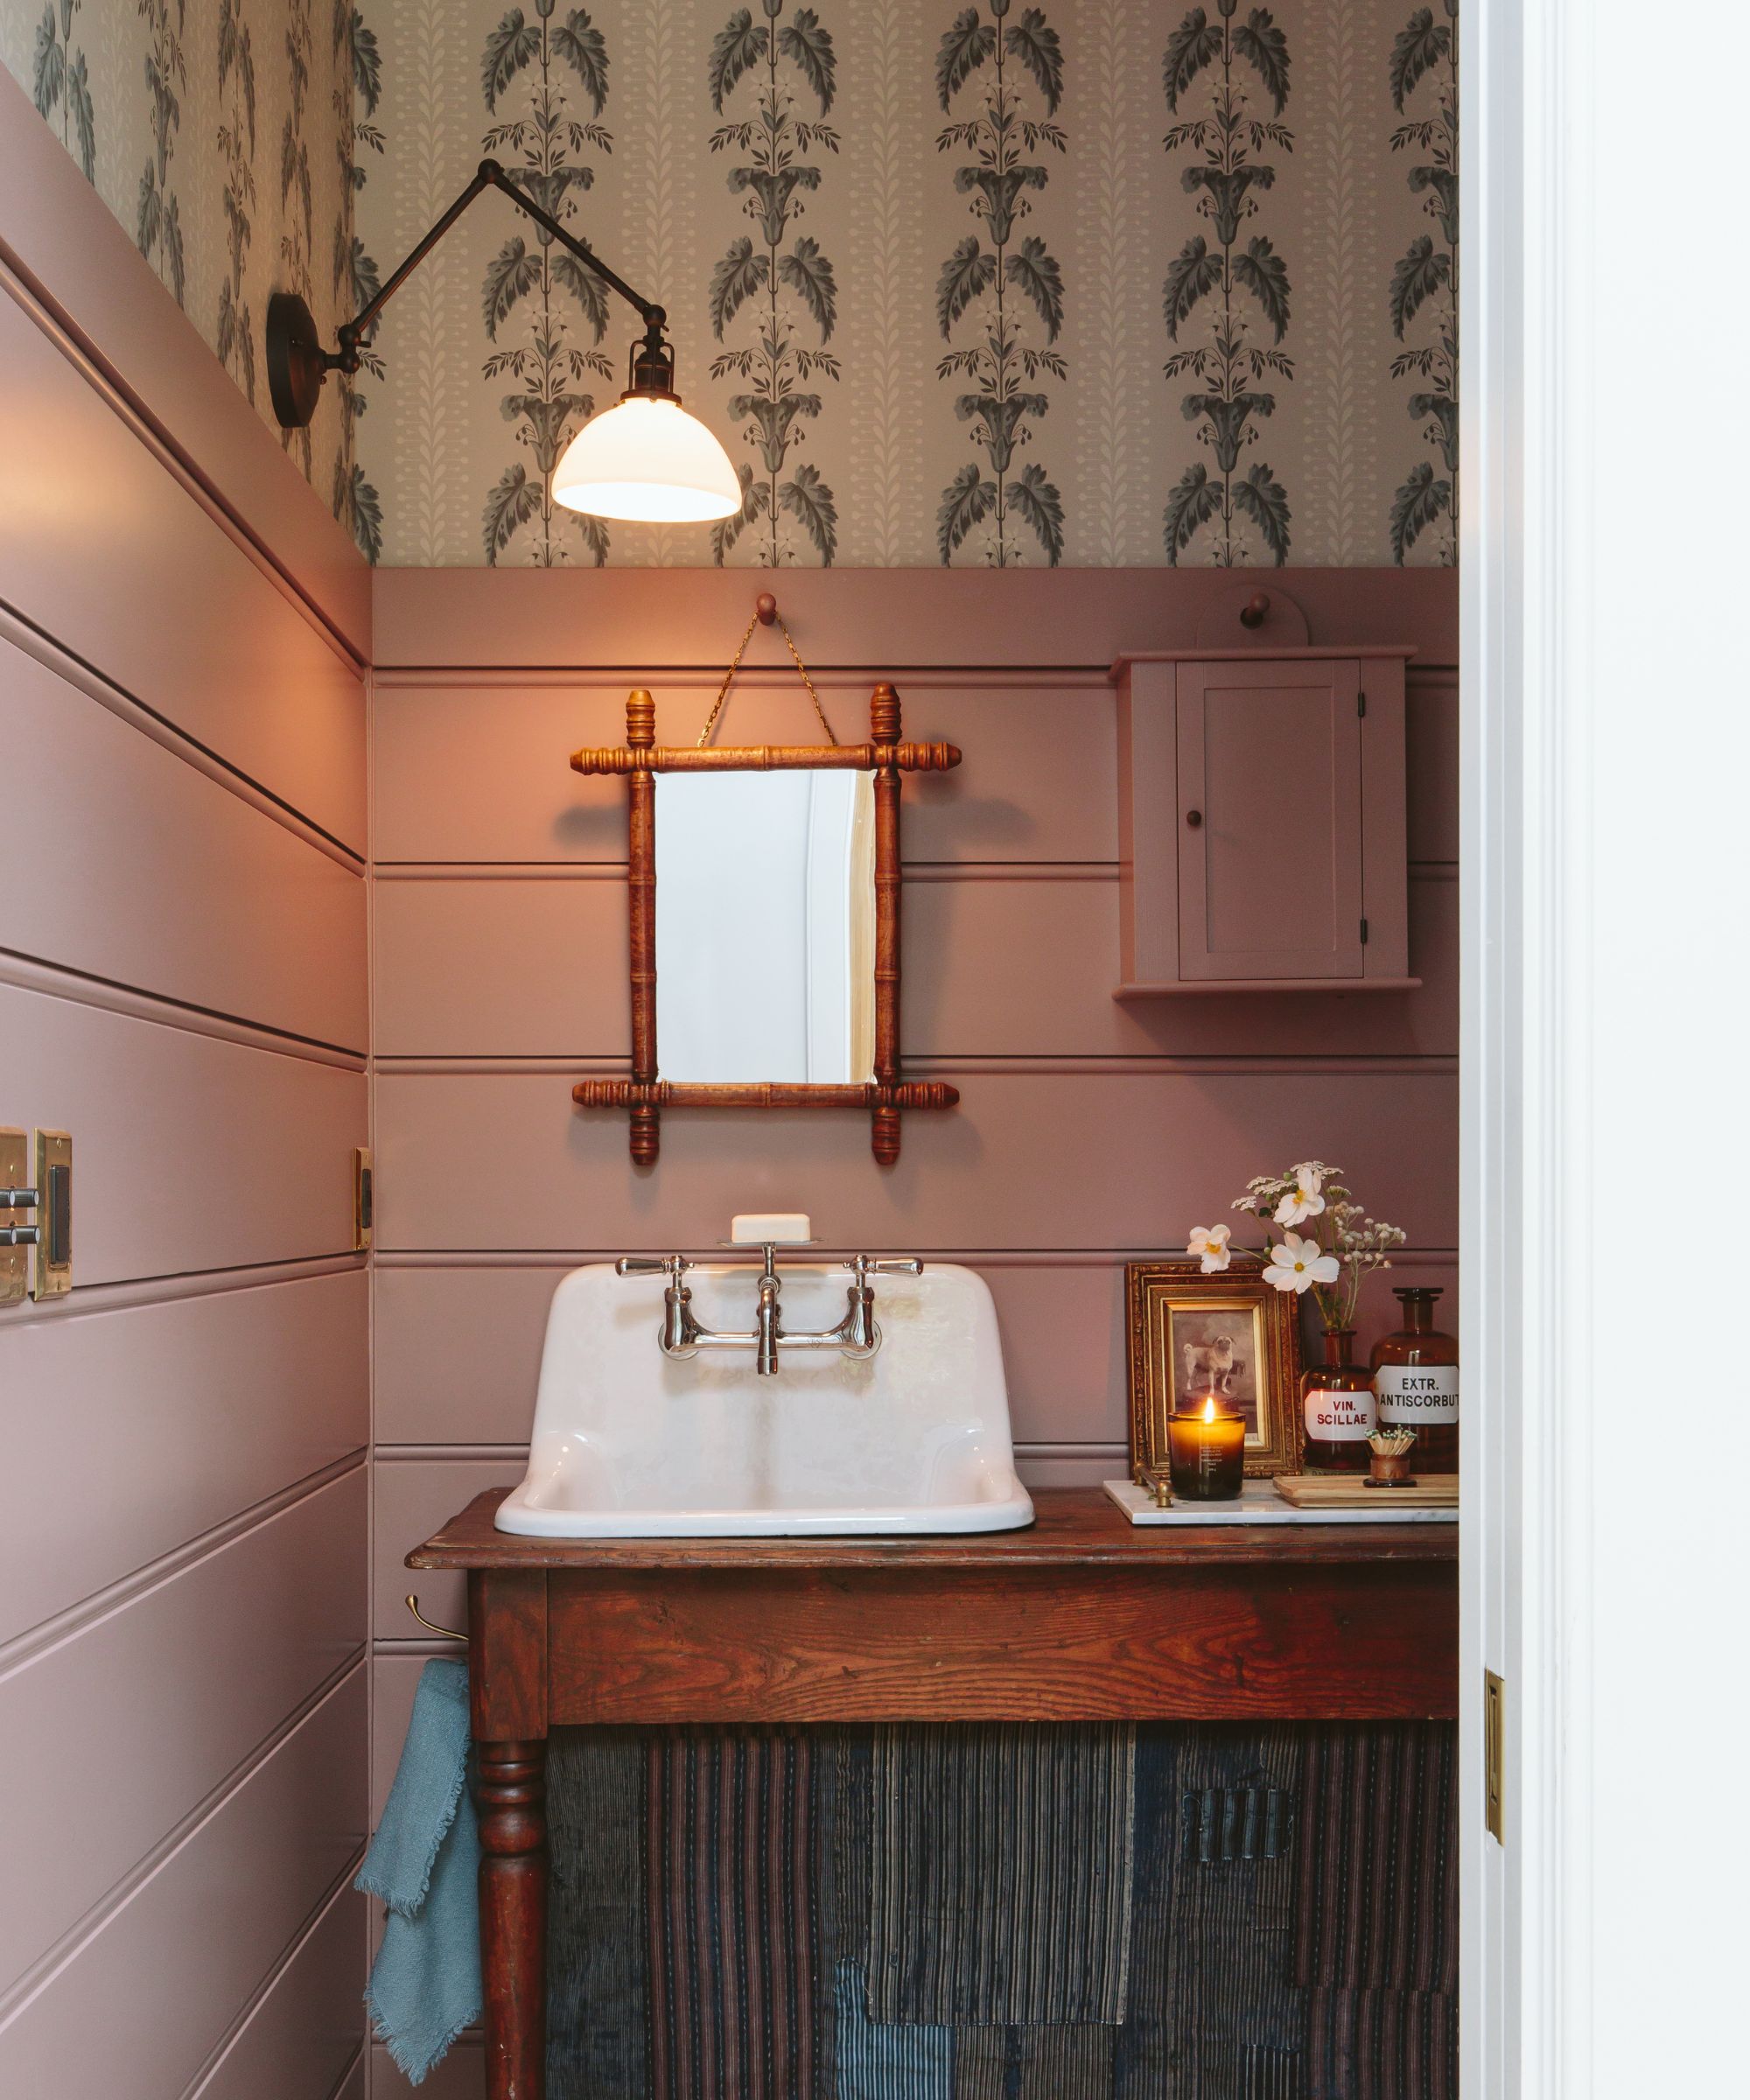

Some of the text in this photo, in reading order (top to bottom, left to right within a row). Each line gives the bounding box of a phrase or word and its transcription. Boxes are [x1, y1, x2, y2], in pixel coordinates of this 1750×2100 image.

[1402, 1377, 1439, 1390] EXTR.
[1333, 1401, 1356, 1410] VIN.
[1317, 1414, 1368, 1424] SCILLAE
